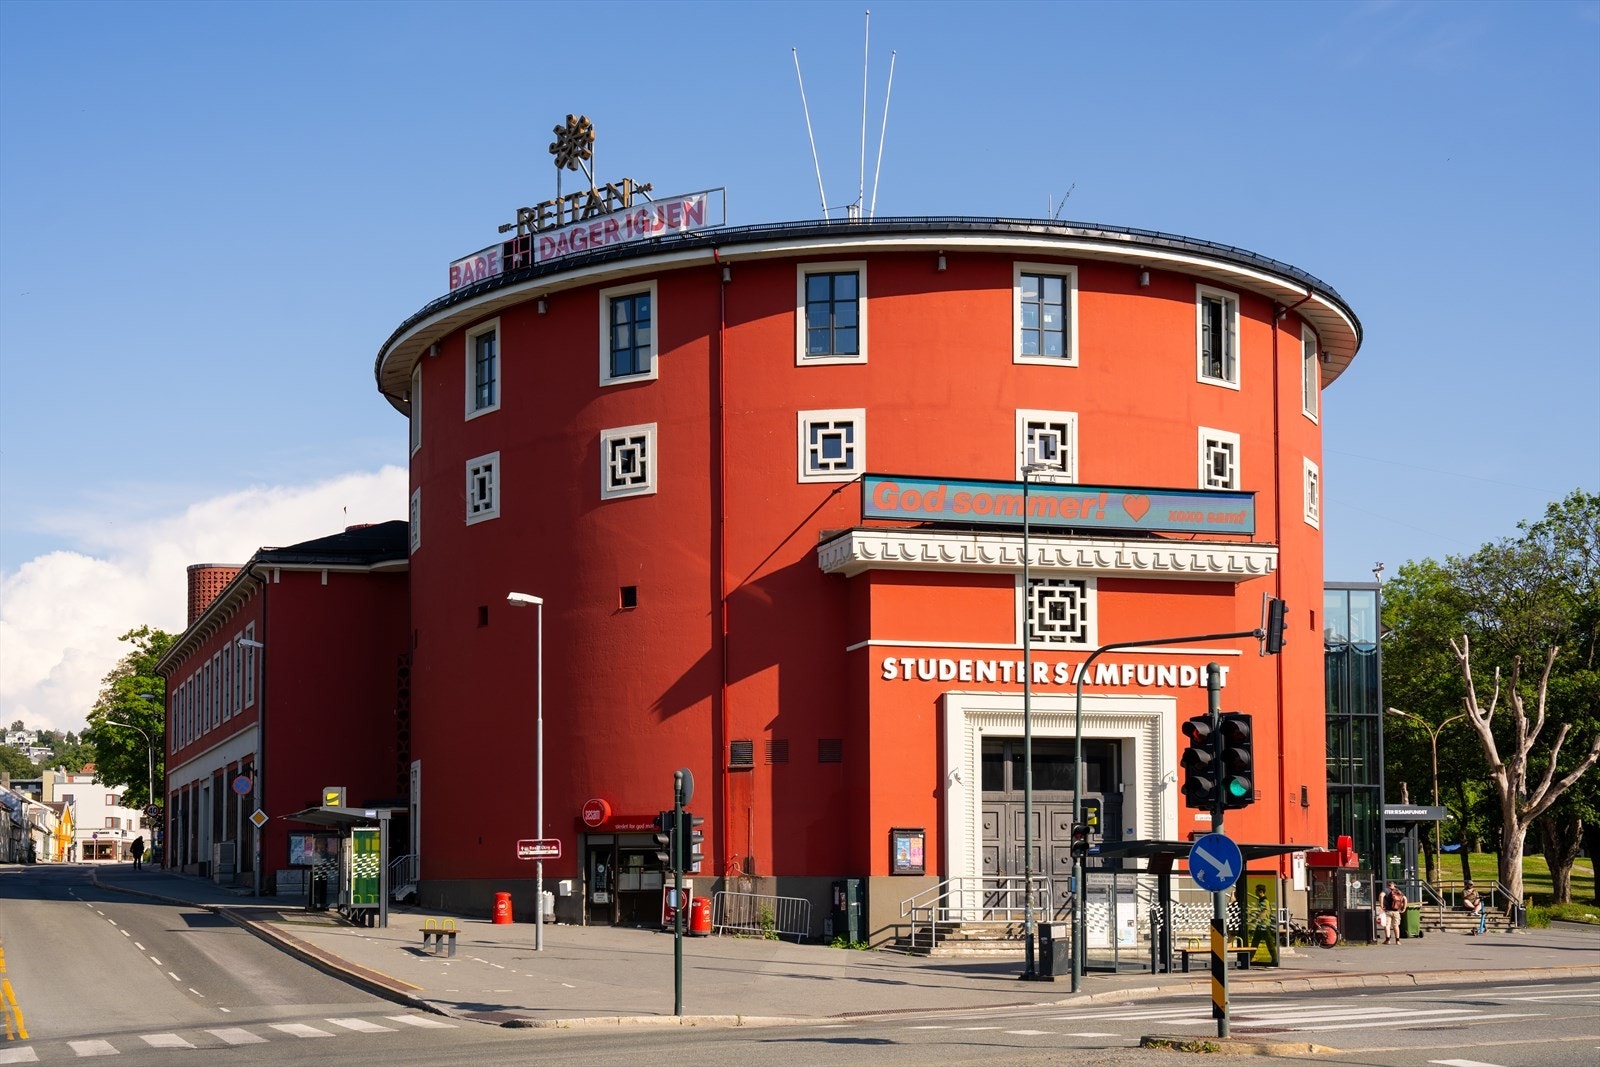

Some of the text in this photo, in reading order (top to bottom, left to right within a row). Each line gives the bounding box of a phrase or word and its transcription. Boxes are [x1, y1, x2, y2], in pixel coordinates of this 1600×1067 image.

[517, 178, 630, 236] REITAN
[450, 200, 704, 289] BARE DAGER IGJEN
[872, 481, 1109, 520] God sommer!
[1168, 510, 1246, 524] xoxo samf
[882, 657, 1230, 688] STUDENTERSAMFUNDET
